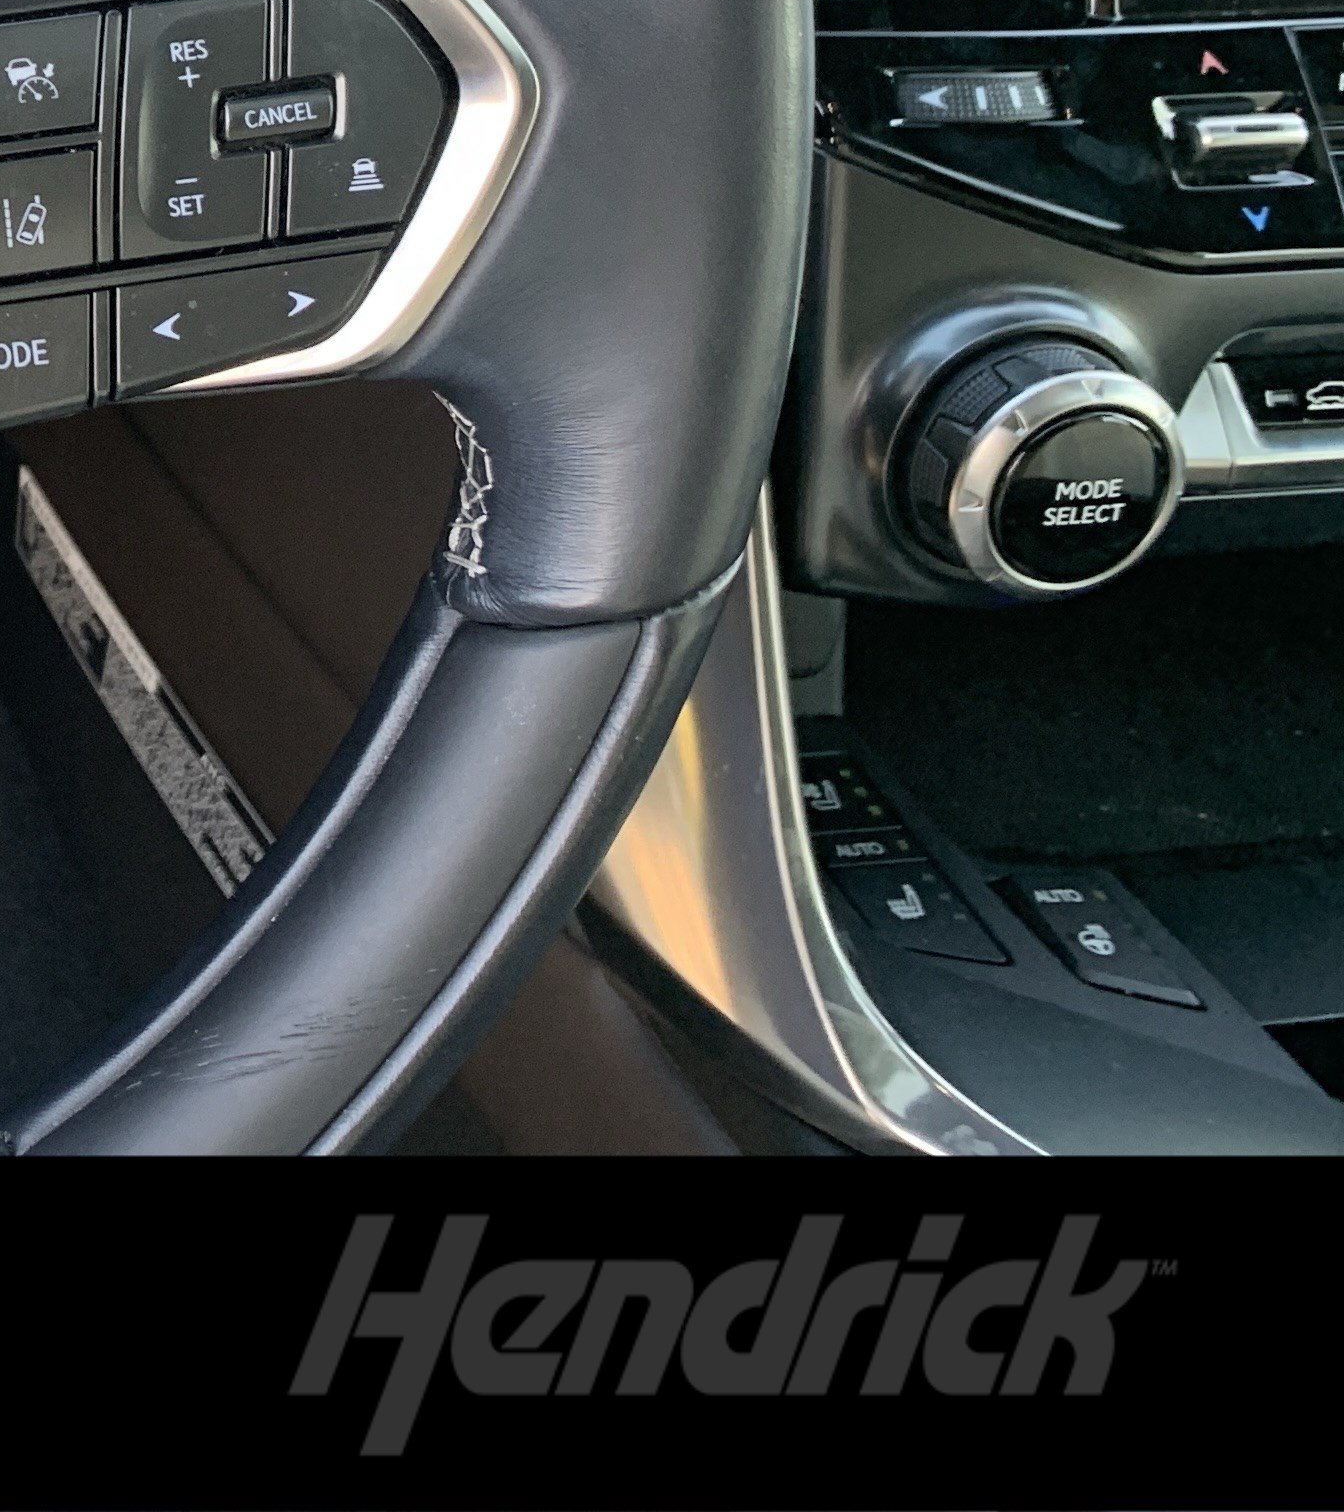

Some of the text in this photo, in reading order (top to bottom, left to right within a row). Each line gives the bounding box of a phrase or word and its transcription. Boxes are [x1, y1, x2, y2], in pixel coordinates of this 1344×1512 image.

[169, 39, 208, 63] RES
[244, 100, 317, 129] CANCEL
[167, 194, 205, 218] SET
[1055, 478, 1124, 501] MODE
[1042, 502, 1128, 526] SELECT
[835, 842, 886, 858] AUTO
[1034, 888, 1085, 904] AUTO
